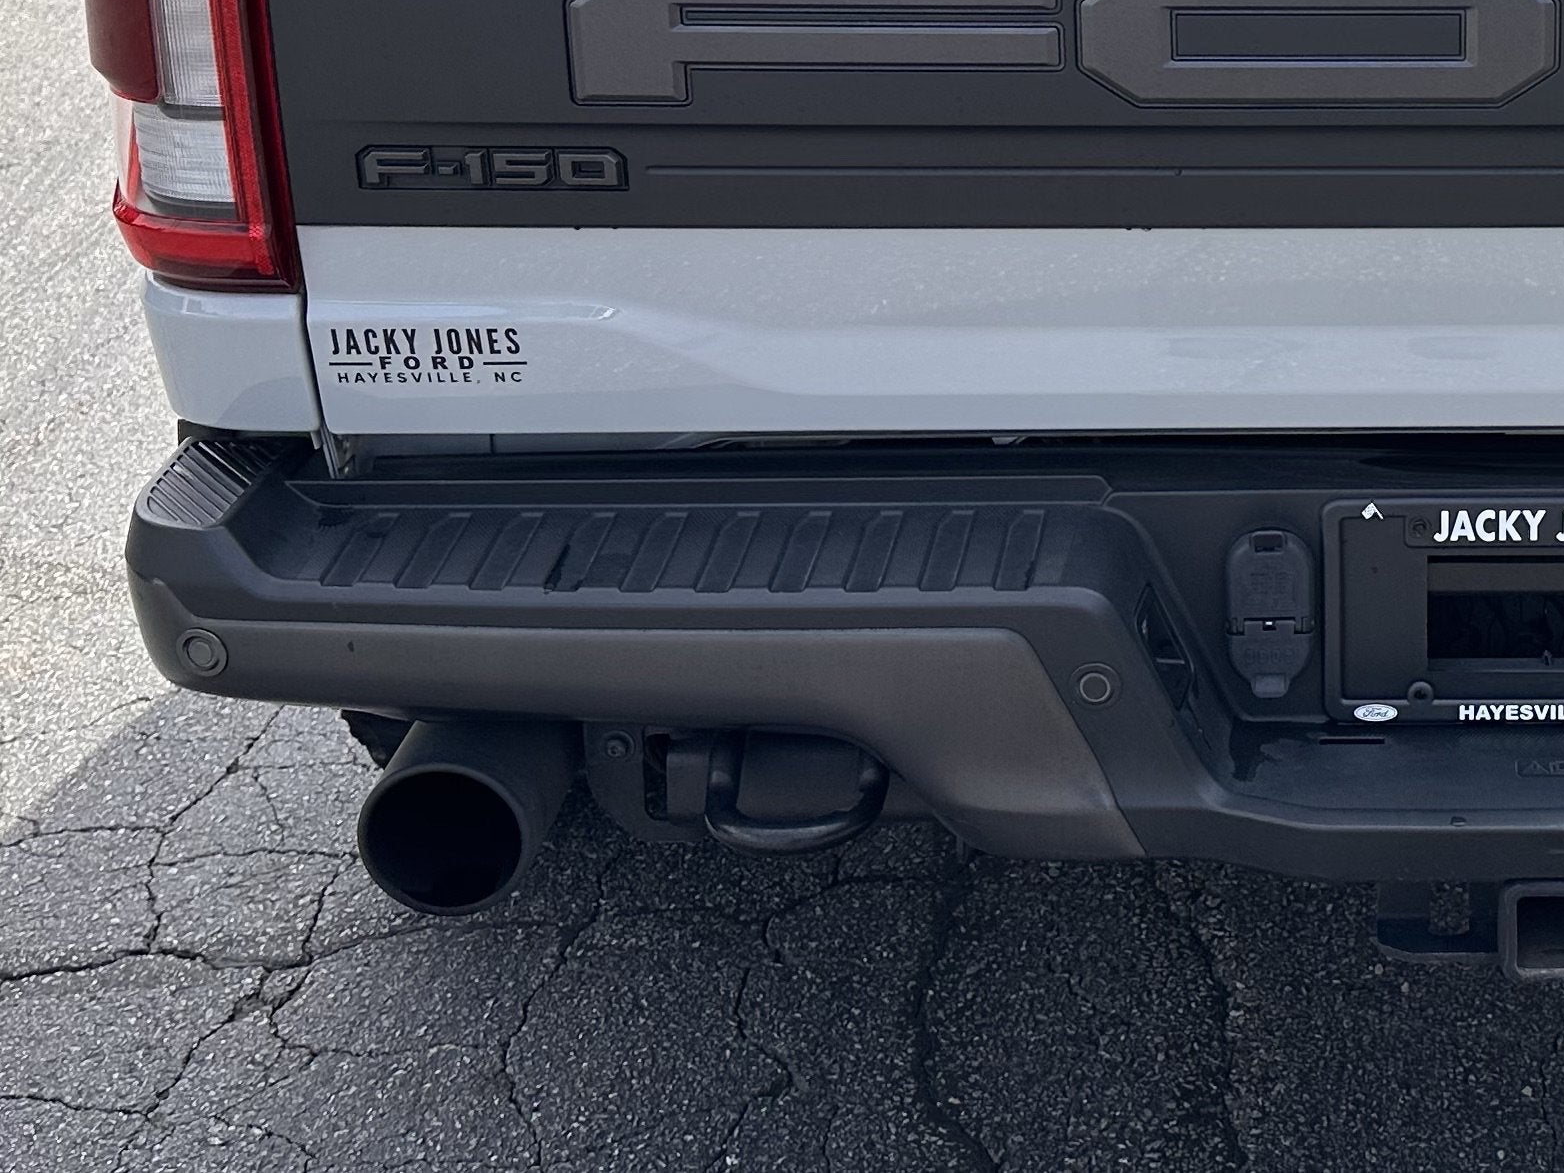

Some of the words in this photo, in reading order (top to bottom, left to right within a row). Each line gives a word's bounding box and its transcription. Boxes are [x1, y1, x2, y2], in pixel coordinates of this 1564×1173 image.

[356, 145, 629, 191] F-150
[331, 328, 416, 355] JACKY
[434, 328, 521, 355] JONES
[379, 356, 474, 370] FORD
[494, 372, 523, 383] NC
[1433, 509, 1546, 543] JACKY
[1363, 707, 1389, 717] Ford
